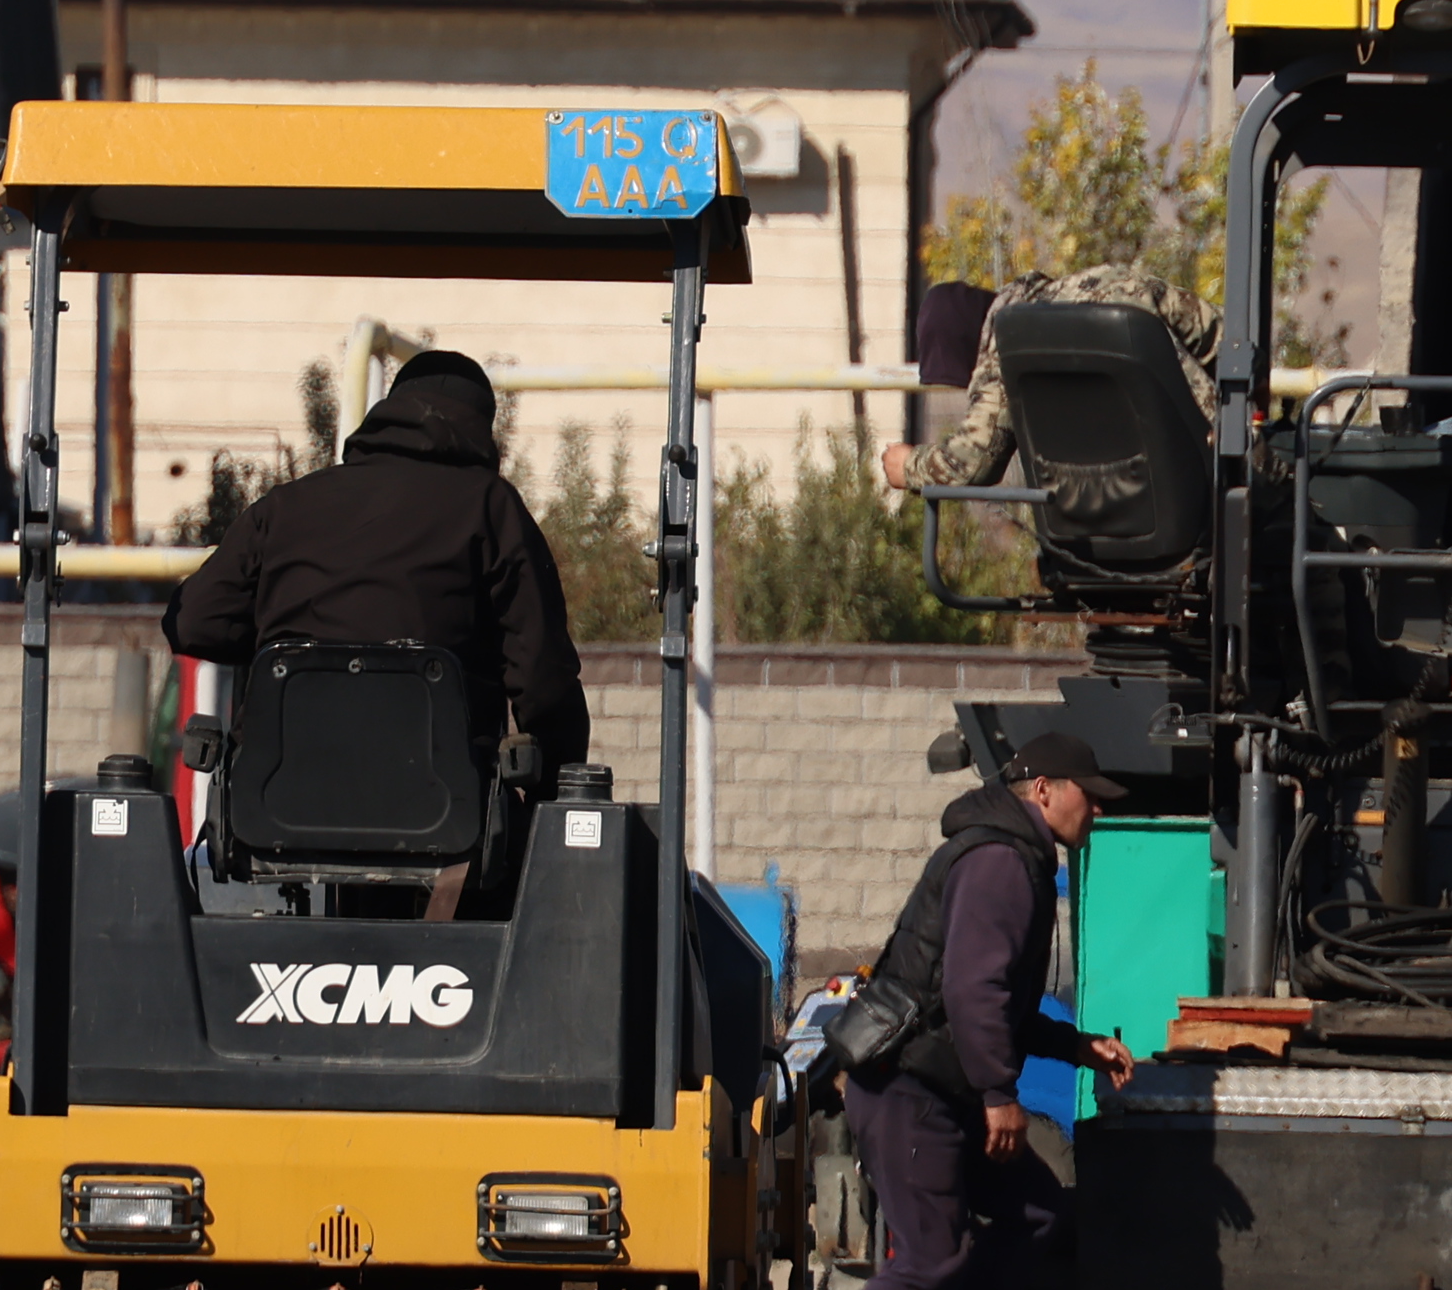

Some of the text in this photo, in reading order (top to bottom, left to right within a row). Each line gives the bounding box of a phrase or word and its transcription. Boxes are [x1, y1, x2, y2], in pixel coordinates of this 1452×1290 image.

[561, 115, 698, 159] 115 Q
[574, 163, 689, 209] AAA
[235, 962, 474, 1028] XCMG
